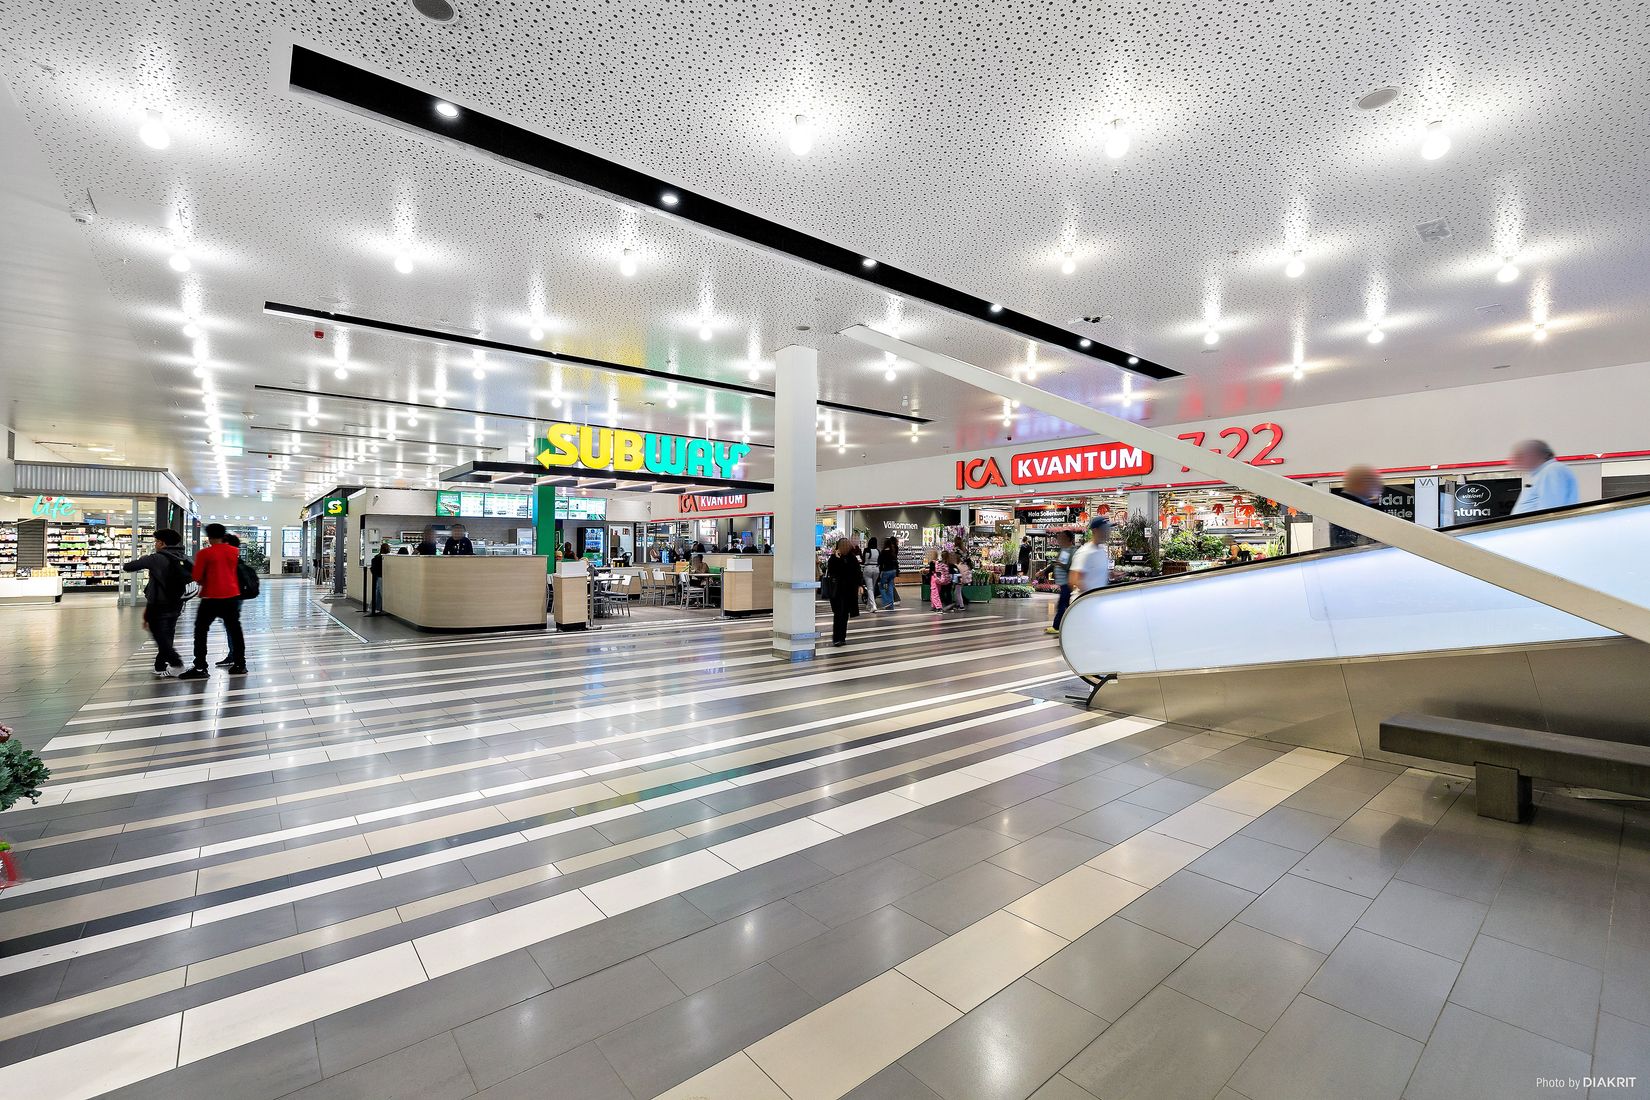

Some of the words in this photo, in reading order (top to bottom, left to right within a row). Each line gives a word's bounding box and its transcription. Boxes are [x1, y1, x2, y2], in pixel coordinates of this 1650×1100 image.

[537, 422, 752, 478] SUBWAY
[956, 456, 1007, 490] ICA
[1018, 447, 1143, 478] KVANTUM
[701, 494, 743, 507] KVANTUM
[883, 520, 918, 530] Välkommen
